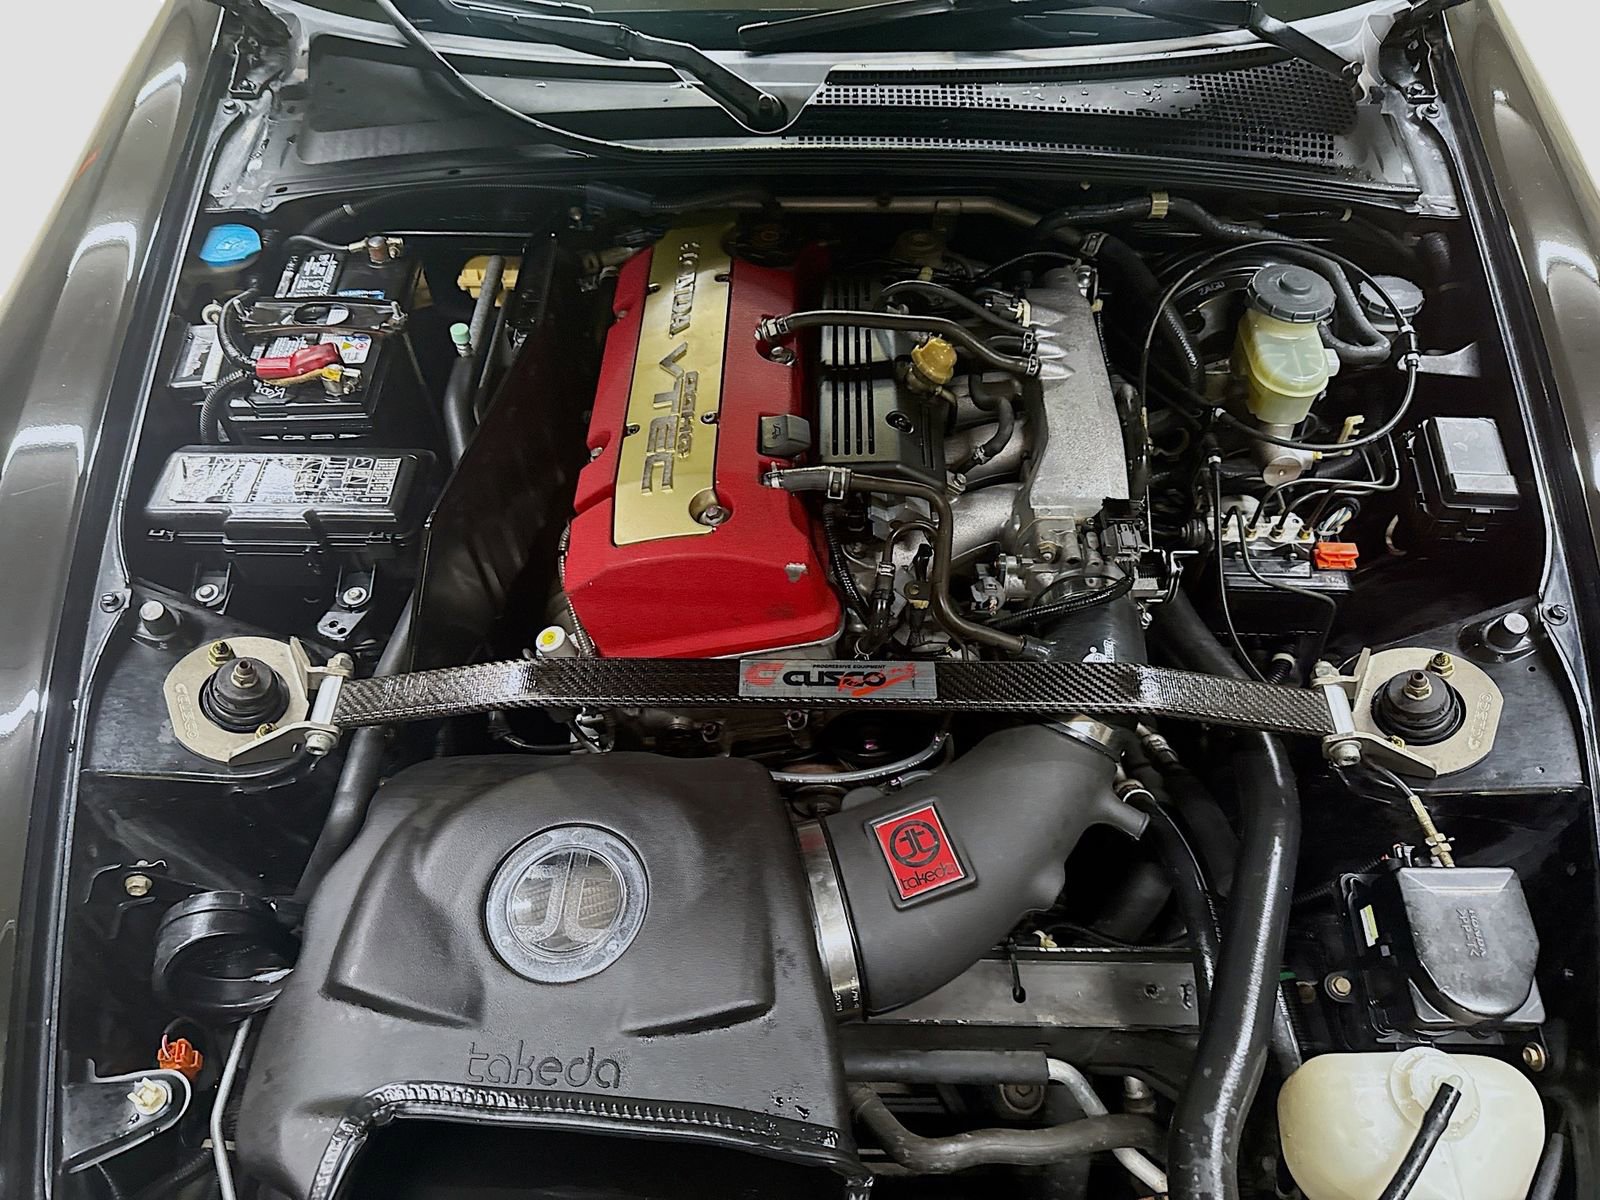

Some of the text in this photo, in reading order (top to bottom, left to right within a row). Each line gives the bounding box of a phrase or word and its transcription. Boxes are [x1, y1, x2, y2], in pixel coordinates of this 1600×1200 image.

[641, 341, 689, 496] VTEC
[677, 370, 699, 459] DOHC
[782, 670, 887, 688] CUSCO
[899, 862, 958, 891] takeda
[1467, 908, 1487, 957] HONDA
[466, 1039, 622, 1089] takeda
